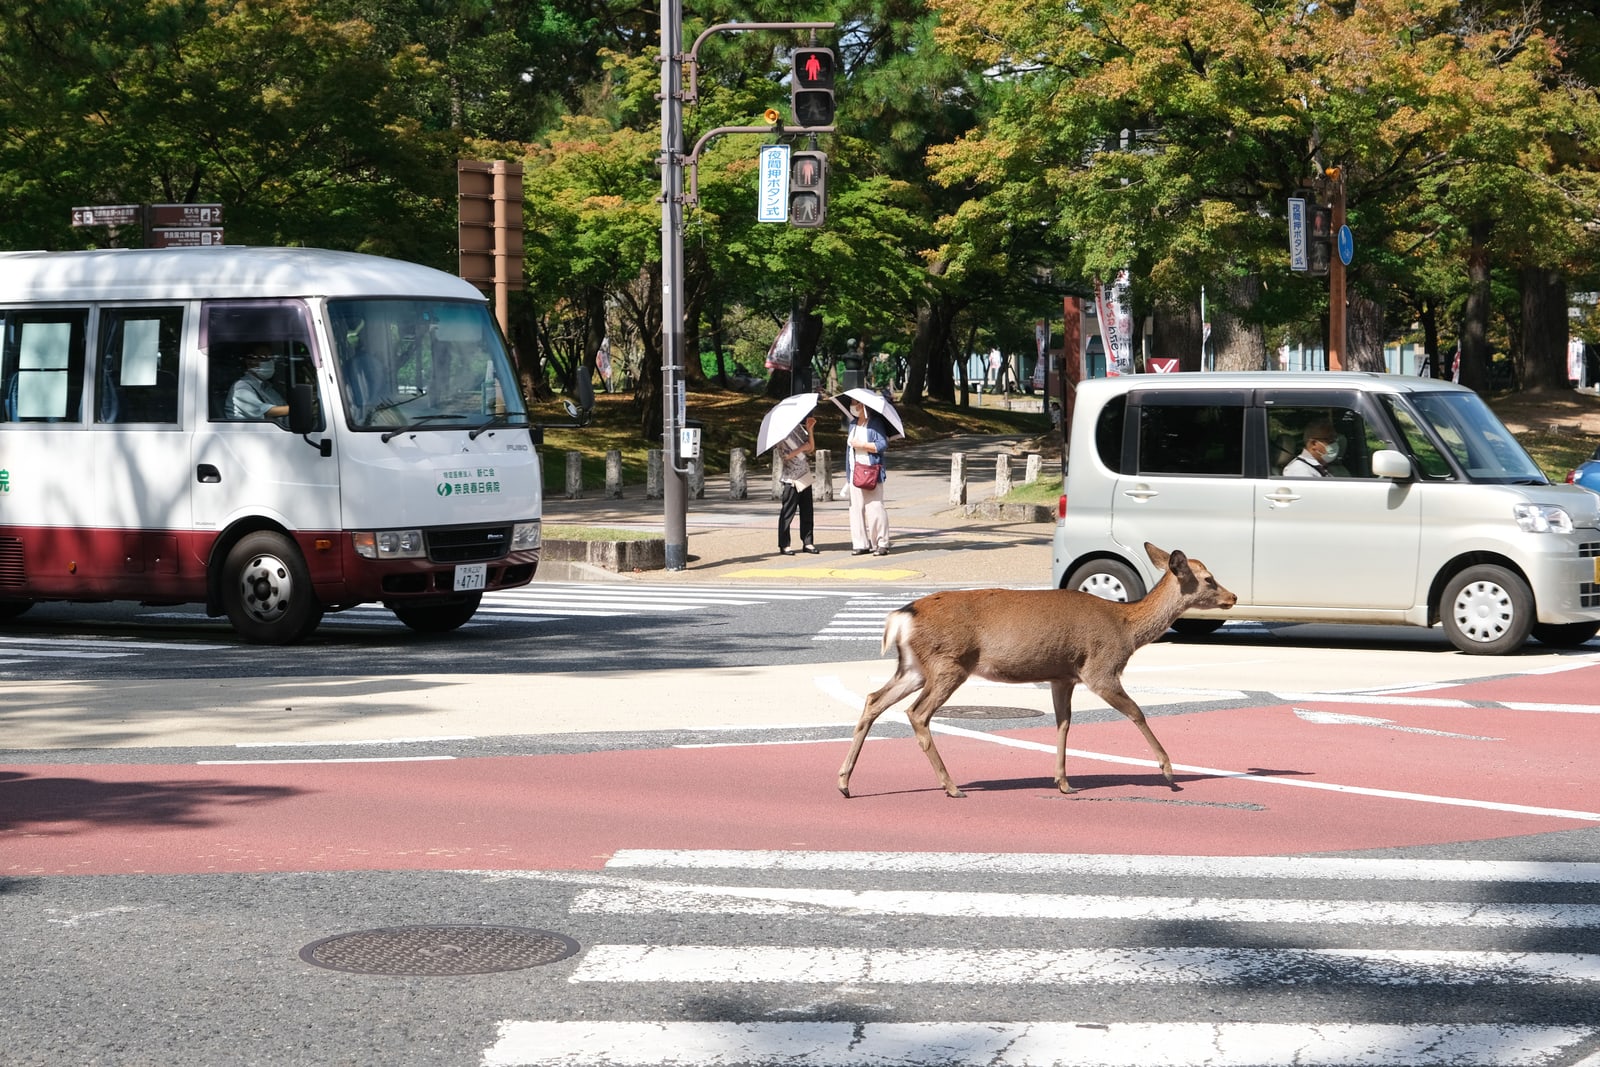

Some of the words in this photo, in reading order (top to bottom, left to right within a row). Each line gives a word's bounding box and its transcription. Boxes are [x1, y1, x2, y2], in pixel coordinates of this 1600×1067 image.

[766, 150, 781, 216] 夜間押ボタン式
[1292, 203, 1303, 266] 夜間押ボタン式
[454, 481, 500, 495] 奈良春日病院
